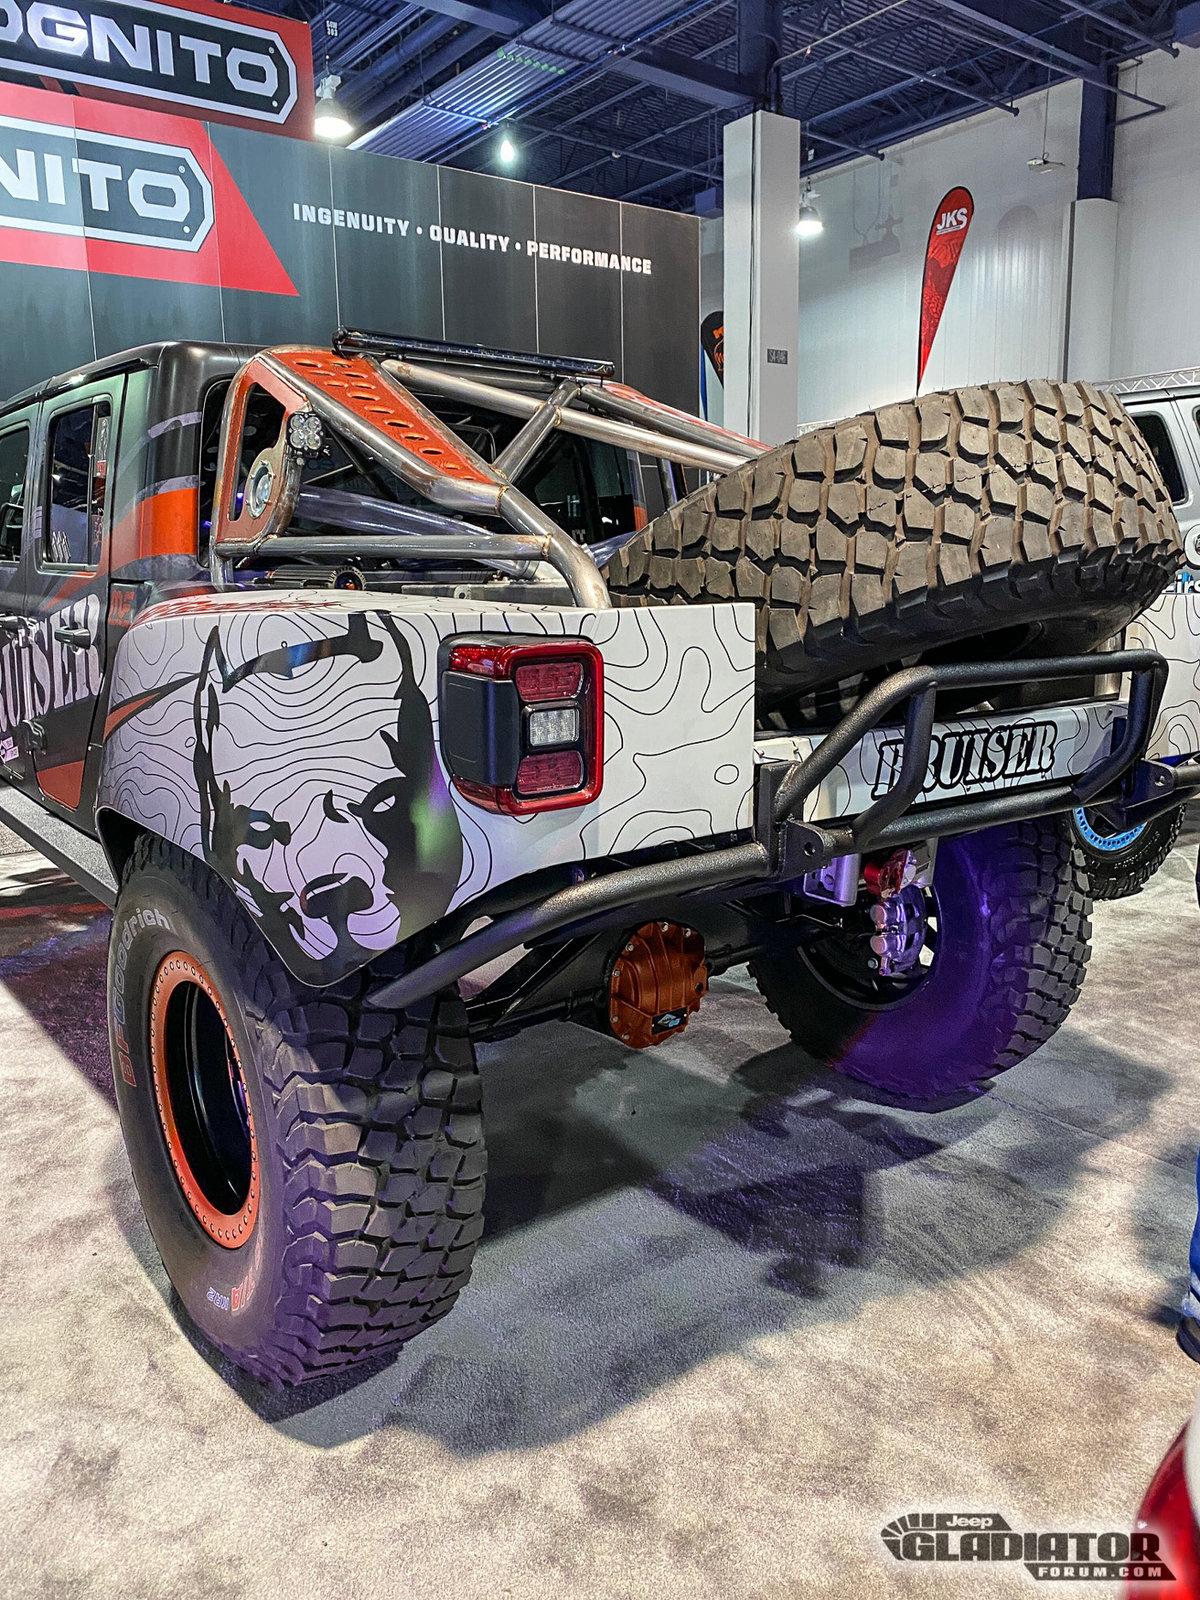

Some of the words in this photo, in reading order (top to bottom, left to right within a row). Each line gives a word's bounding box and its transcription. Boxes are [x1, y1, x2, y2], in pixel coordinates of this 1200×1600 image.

[292, 202, 410, 237] INGENUITY
[429, 224, 510, 253] QUALITY
[526, 240, 652, 275] PERFORMANCE
[936, 207, 968, 231] JKS
[112, 907, 171, 1087] BFGoodrich
